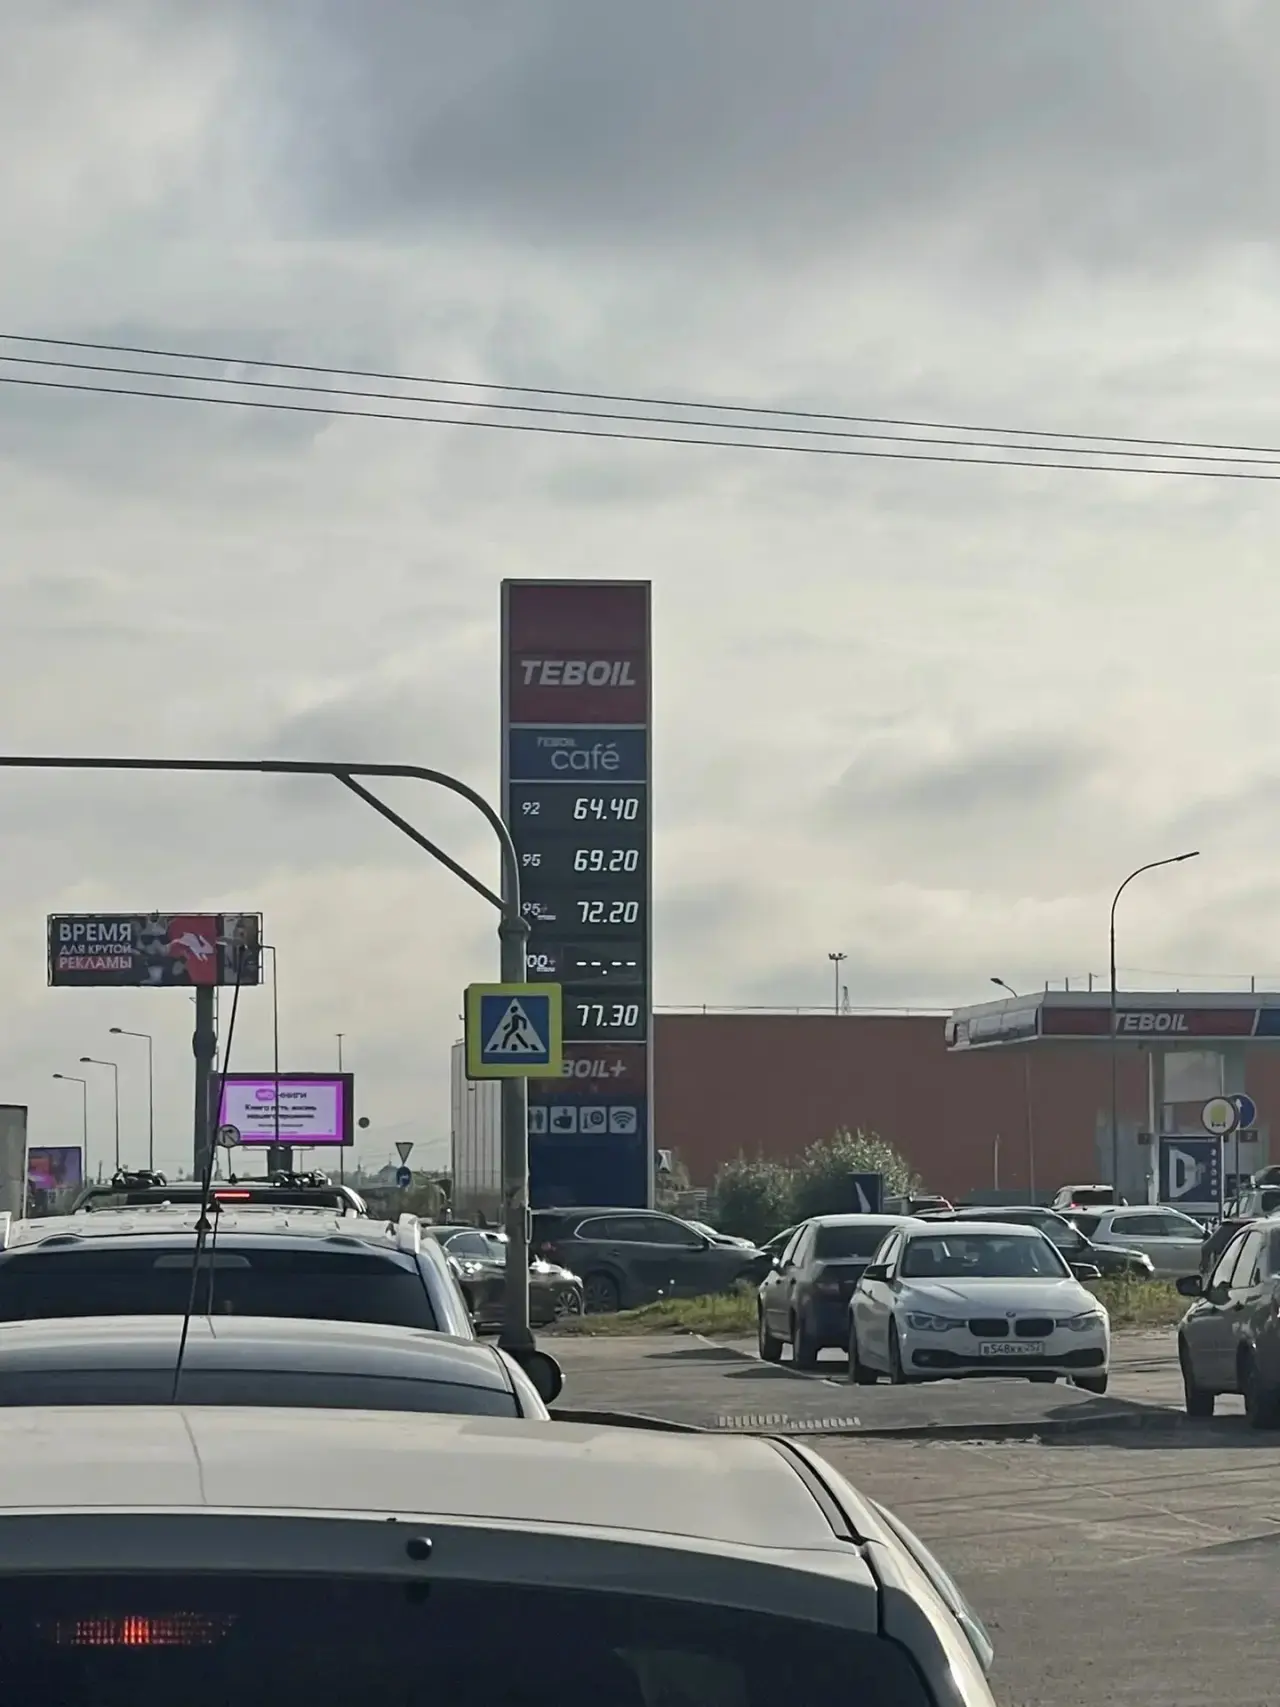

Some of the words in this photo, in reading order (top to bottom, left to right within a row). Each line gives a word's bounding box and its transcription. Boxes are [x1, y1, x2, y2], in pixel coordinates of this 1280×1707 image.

[520, 660, 636, 686] TEBOIL
[550, 743, 620, 770] café
[521, 802, 540, 815] 92
[573, 797, 639, 820] 64.40
[522, 854, 541, 867] 95
[573, 848, 639, 872] 69.20
[577, 901, 639, 923] 72.20
[59, 923, 132, 942] ВРЕМЯ
[59, 944, 85, 955] ДЛЯ
[88, 942, 132, 954] КРУТОЙ
[59, 956, 132, 969] РЕКЛАМЫ
[576, 1005, 639, 1027] 77.30
[1114, 1012, 1189, 1032] TEBOIL
[562, 1059, 627, 1078] BOIL+
